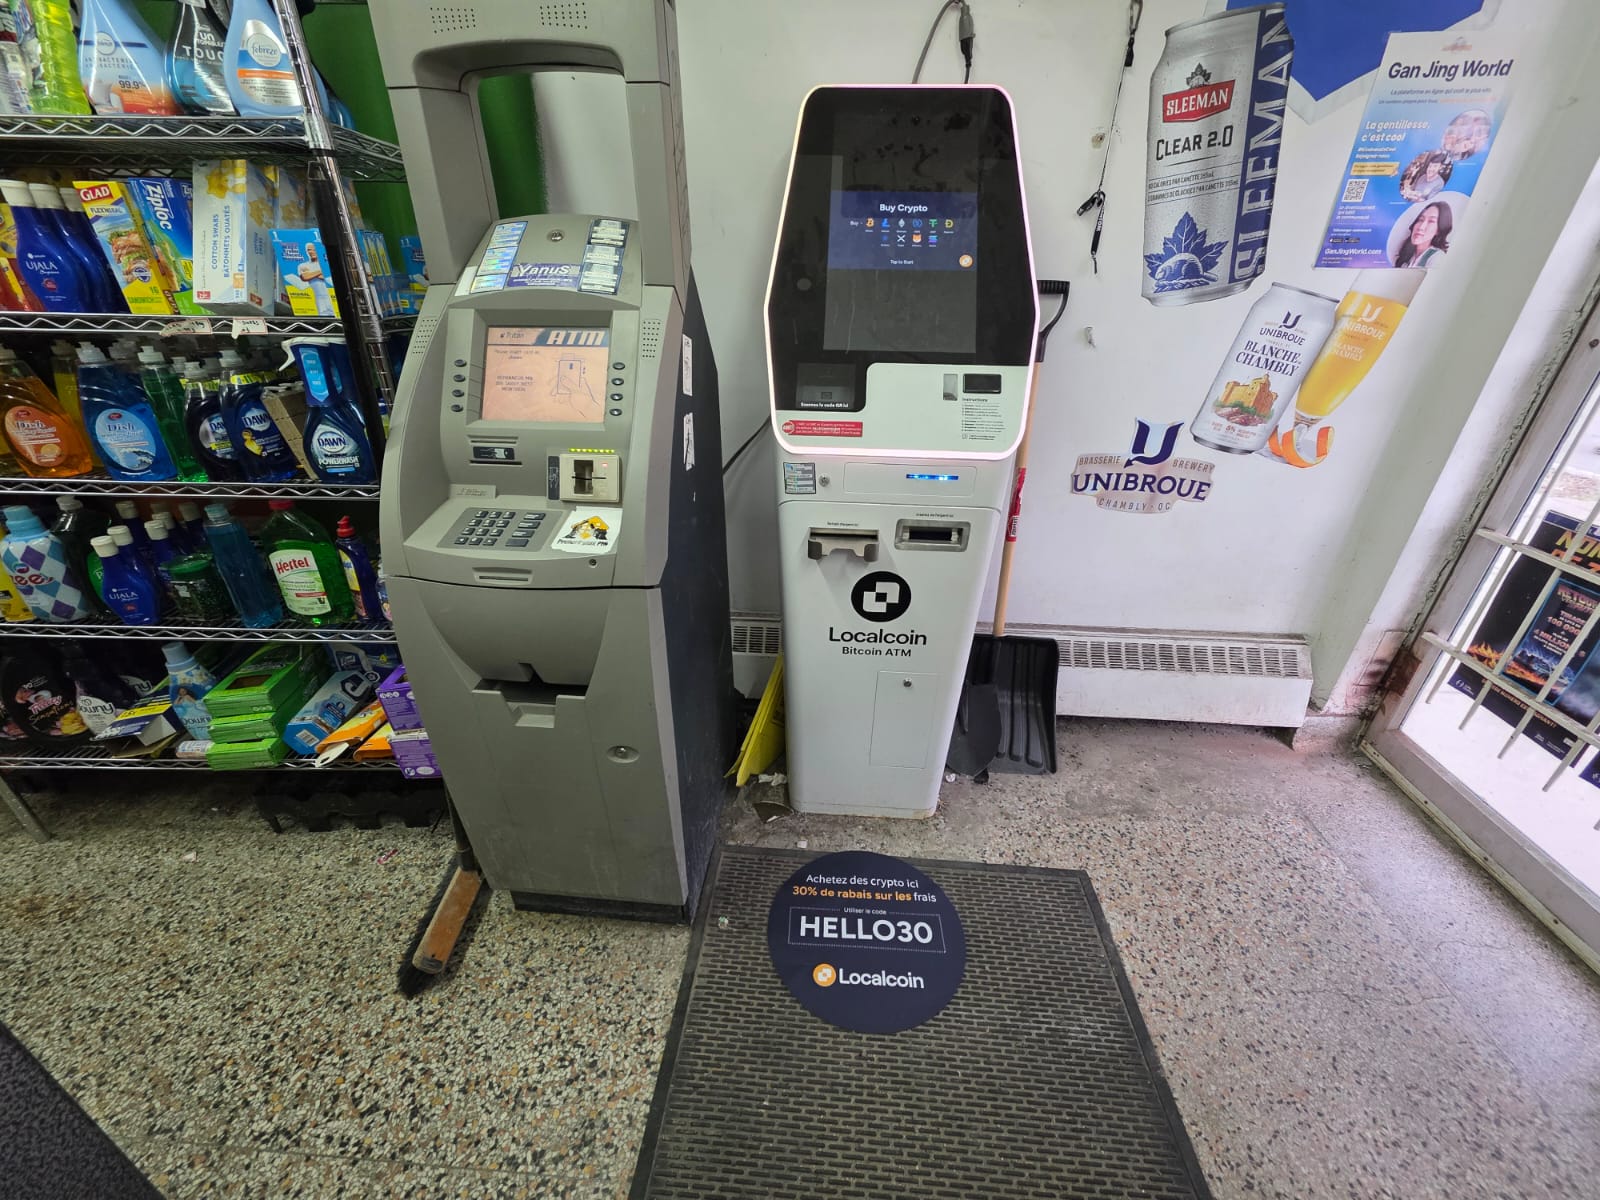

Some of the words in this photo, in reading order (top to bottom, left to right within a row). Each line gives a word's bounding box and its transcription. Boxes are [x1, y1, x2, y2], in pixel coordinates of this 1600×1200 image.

[1388, 62, 1421, 79] Gan
[1422, 60, 1459, 82] Jing
[1462, 59, 1514, 78] World
[1166, 88, 1229, 116] SLEEMAN
[1365, 121, 1376, 130] La
[1207, 125, 1234, 148] 2.0
[1386, 132, 1407, 142] cool
[80, 186, 110, 201] GLAD
[145, 184, 173, 231] Ziploc
[880, 204, 896, 213] Buy
[897, 204, 928, 214] Crypto
[212, 213, 220, 238] SWABS
[211, 240, 219, 270] COTTON
[546, 330, 606, 345] ATM
[1259, 327, 1306, 346] UNIBROUE
[1235, 351, 1300, 377] CHAMBLY
[107, 422, 136, 432] Dish
[317, 437, 347, 449] DAWN
[1079, 455, 1122, 466] BRASSERIE
[1172, 459, 1216, 473] BREWERY
[1073, 472, 1212, 501] UNIBROUE
[1098, 498, 1147, 511] CHAMBLY
[275, 556, 310, 575] Hertel
[829, 627, 928, 645] Localcoin
[842, 646, 882, 656] Bitcoin
[885, 648, 912, 657] ATM
[806, 874, 848, 885] Achetez
[850, 875, 868, 886] des
[870, 878, 904, 889] crypto
[906, 879, 919, 889] ici
[792, 886, 818, 896] 30%
[820, 887, 835, 897] de
[837, 889, 872, 900] rabais
[875, 892, 892, 901] sur
[895, 891, 912, 901] les
[913, 892, 937, 903] frais
[799, 915, 933, 944] HELLO30
[838, 967, 925, 989] Localcoin
